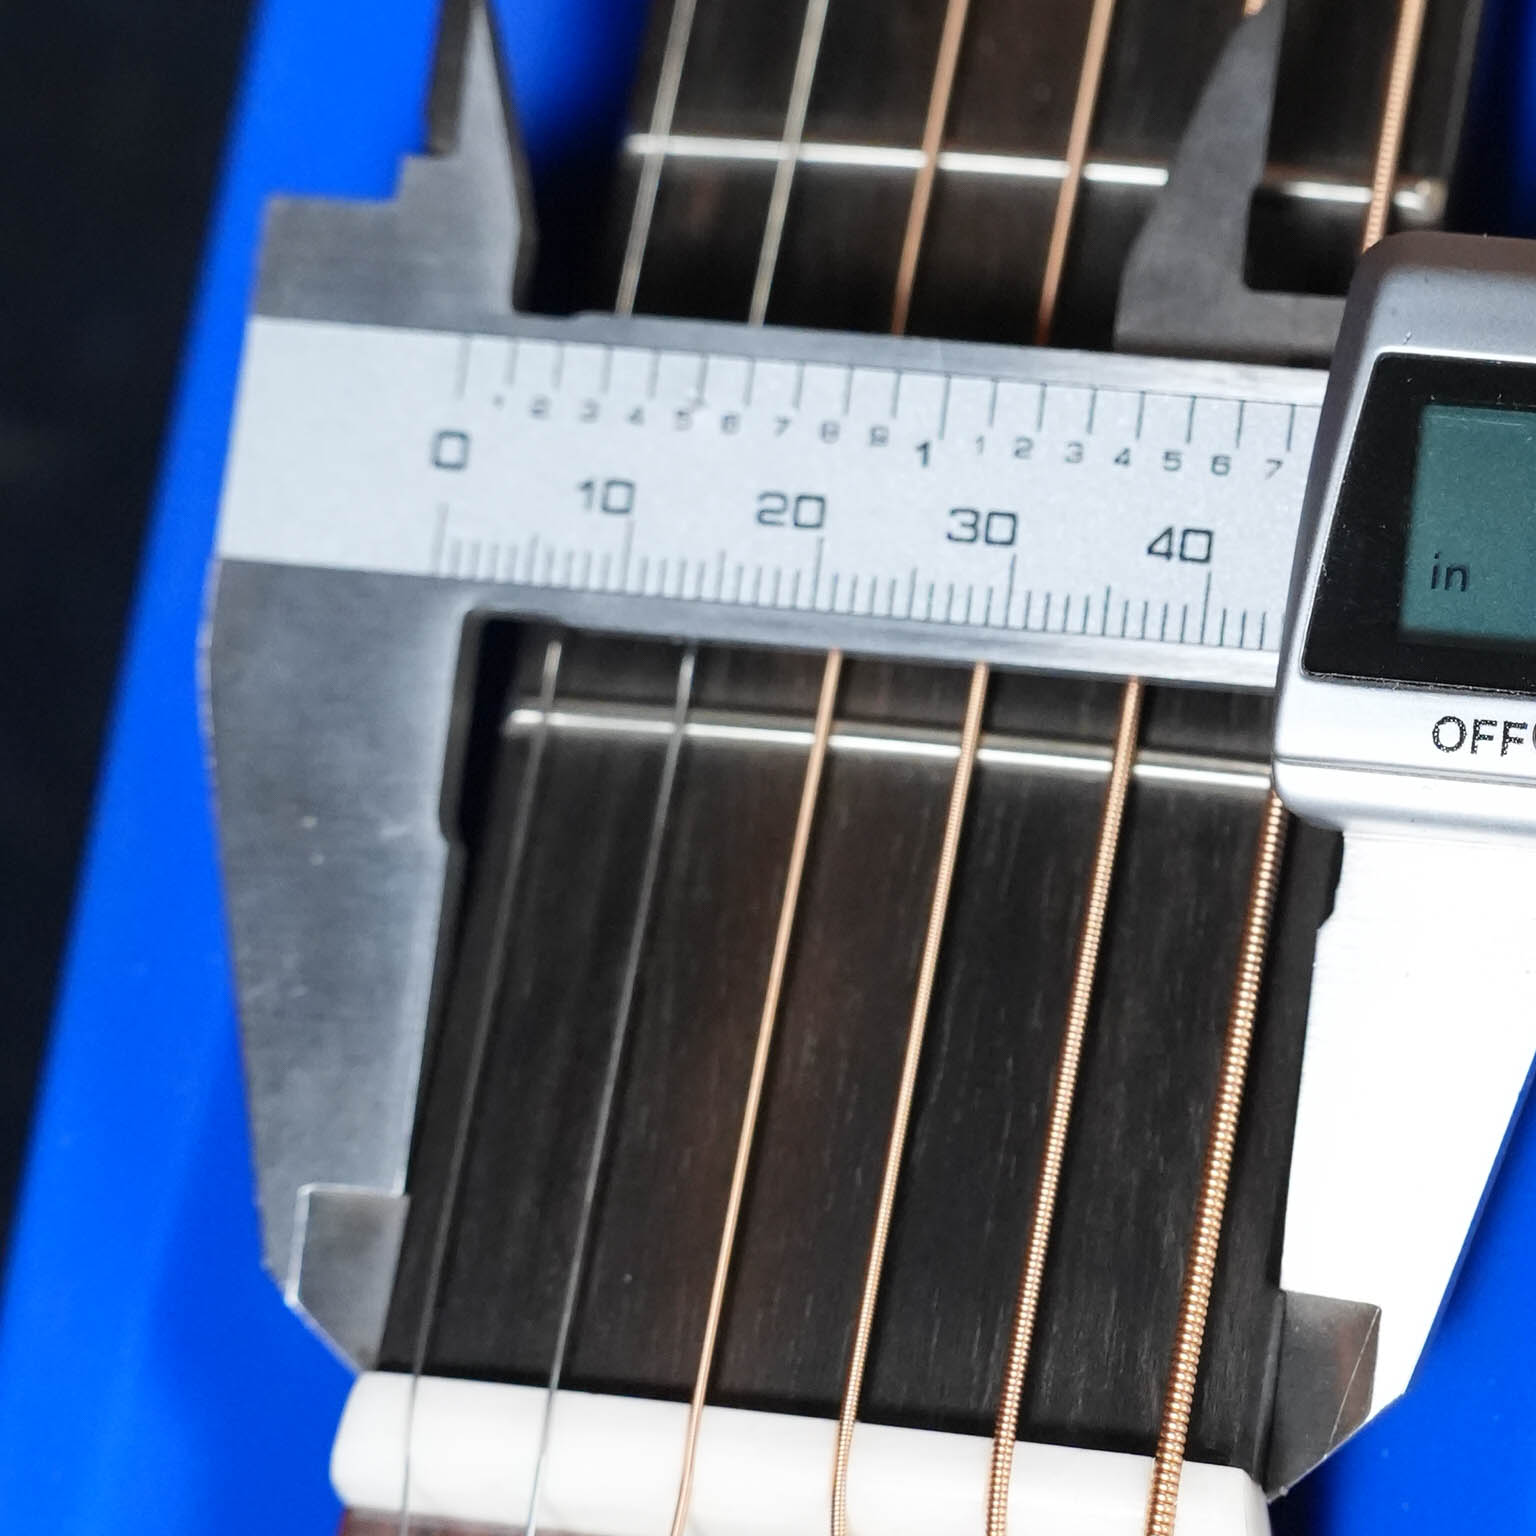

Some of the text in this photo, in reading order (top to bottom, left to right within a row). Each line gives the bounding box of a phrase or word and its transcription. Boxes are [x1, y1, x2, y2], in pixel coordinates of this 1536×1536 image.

[774, 416, 792, 437] 7
[916, 440, 931, 468] 1
[1013, 437, 1034, 459] 2
[1064, 441, 1084, 464] 3
[1113, 447, 1131, 467] 4
[1162, 451, 1182, 472] 5
[1210, 455, 1231, 476] 6
[1264, 458, 1284, 480] 7
[432, 430, 1214, 564] 0 10 20 30 40
[1430, 551, 1470, 593] in
[1432, 716, 1530, 756] OFF
